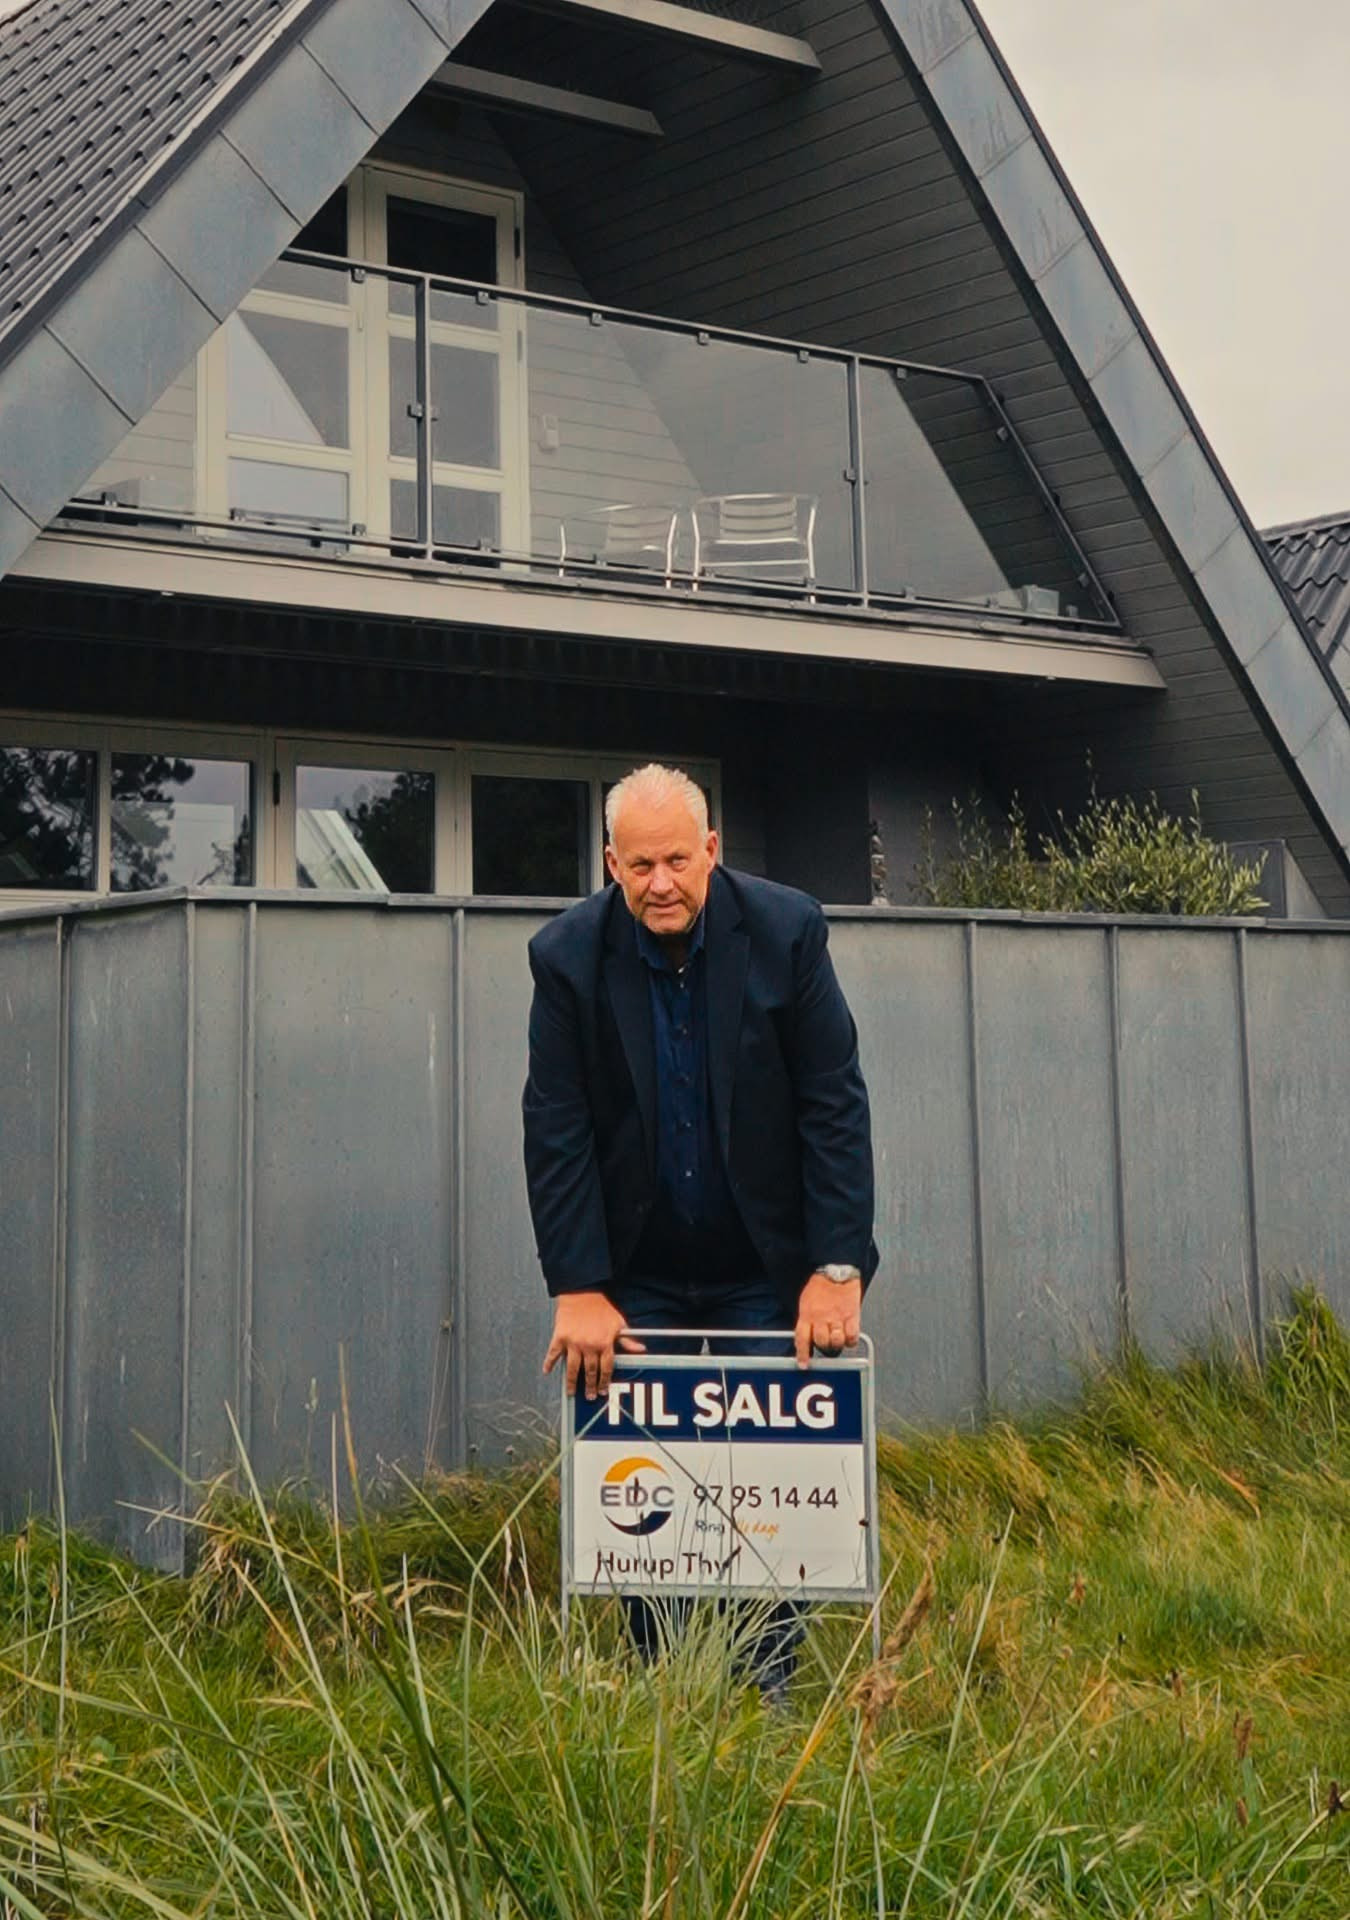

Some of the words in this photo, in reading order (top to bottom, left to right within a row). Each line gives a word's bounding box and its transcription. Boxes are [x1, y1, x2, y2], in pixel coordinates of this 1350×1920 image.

[608, 1382, 679, 1426] TIL
[693, 1382, 835, 1429] SALG
[600, 1485, 675, 1507] EDC
[694, 1485, 724, 1508] 97
[732, 1485, 762, 1508] 95
[771, 1486, 801, 1509] 14
[807, 1487, 839, 1509] 44
[695, 1520, 725, 1536] Ring
[597, 1551, 674, 1580] Hurup
[682, 1552, 730, 1580] Thy
